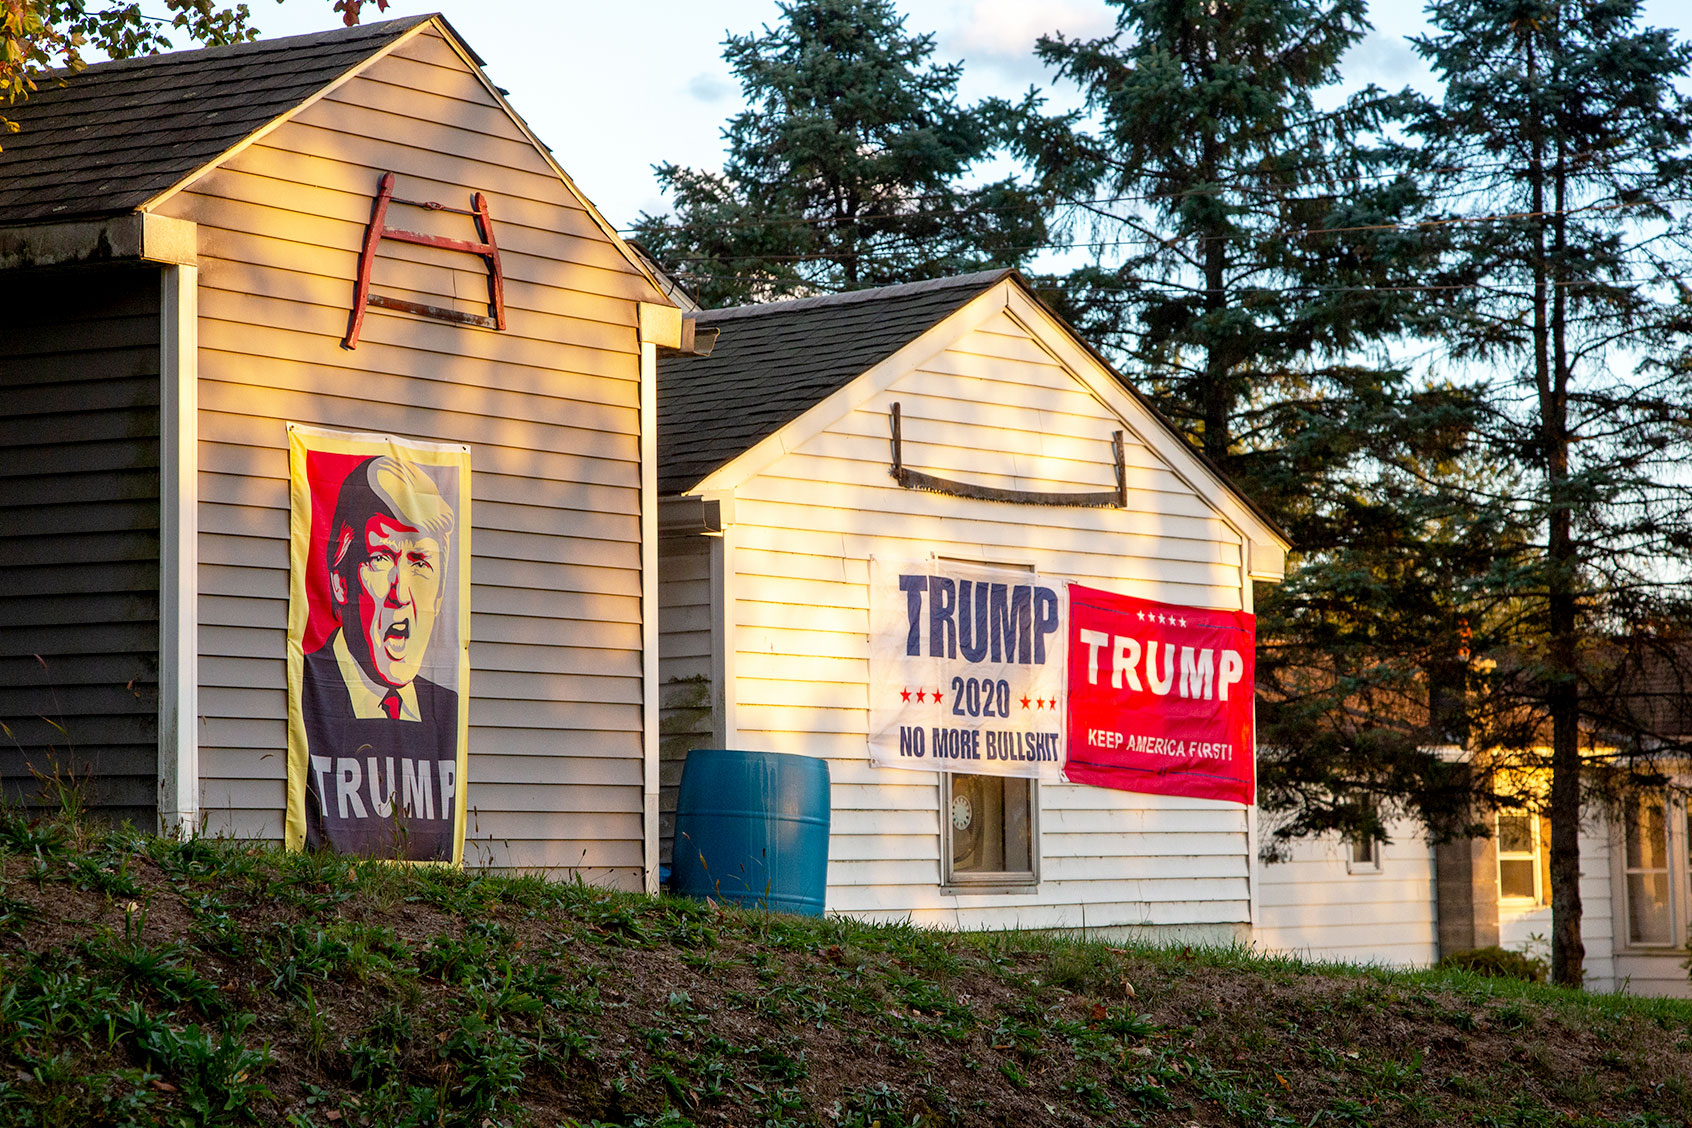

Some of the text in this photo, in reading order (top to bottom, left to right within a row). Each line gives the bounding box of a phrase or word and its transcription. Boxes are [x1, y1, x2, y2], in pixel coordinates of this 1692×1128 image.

[900, 574, 1059, 665] TRUMP
[1080, 628, 1244, 702] TRUMP
[951, 676, 1010, 719] 2020
[900, 725, 1059, 762] NO MORE BULLSHIT
[1088, 728, 1233, 761] KEEP AMERICA FIRST!
[310, 753, 456, 820] TRUMP
